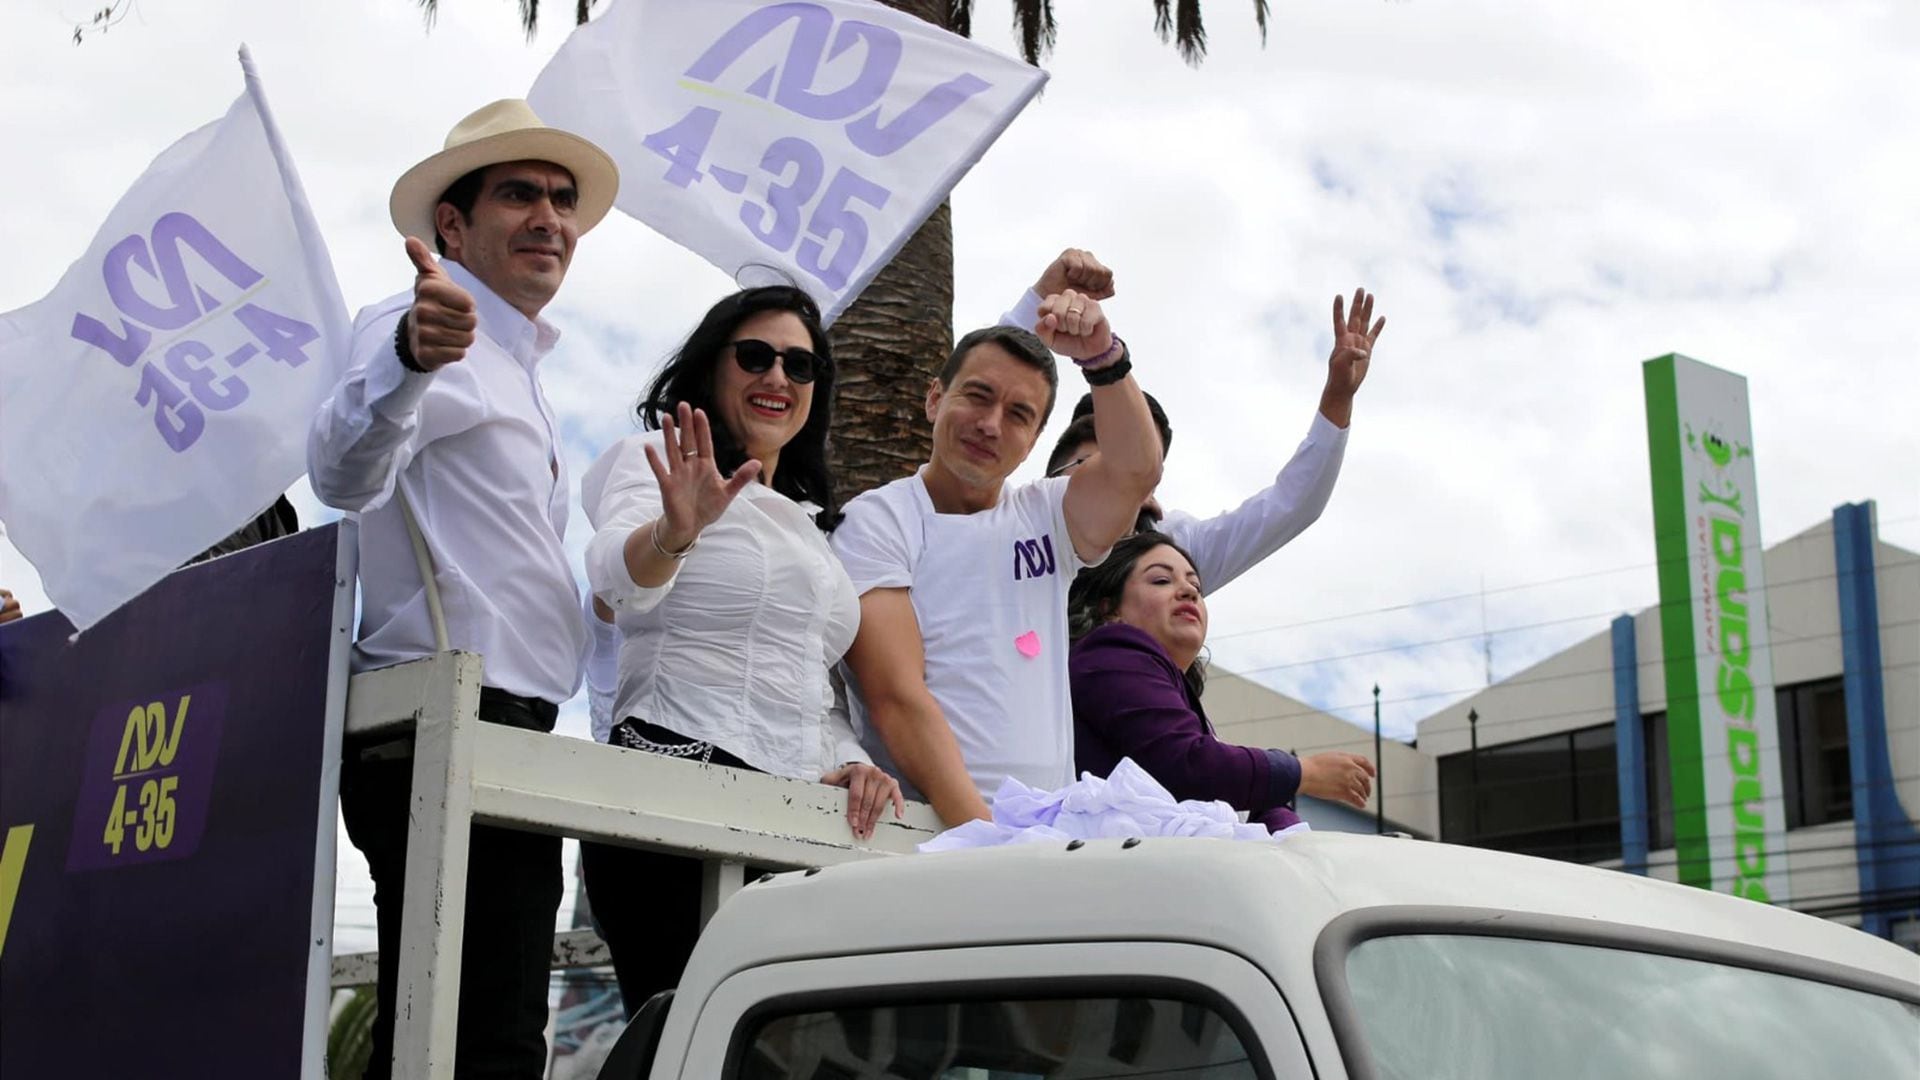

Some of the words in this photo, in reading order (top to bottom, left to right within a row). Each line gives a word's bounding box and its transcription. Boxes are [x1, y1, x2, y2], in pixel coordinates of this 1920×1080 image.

[641, 106, 891, 292] 4-35
[113, 695, 191, 776] ADJ
[103, 776, 178, 854] 4-35
